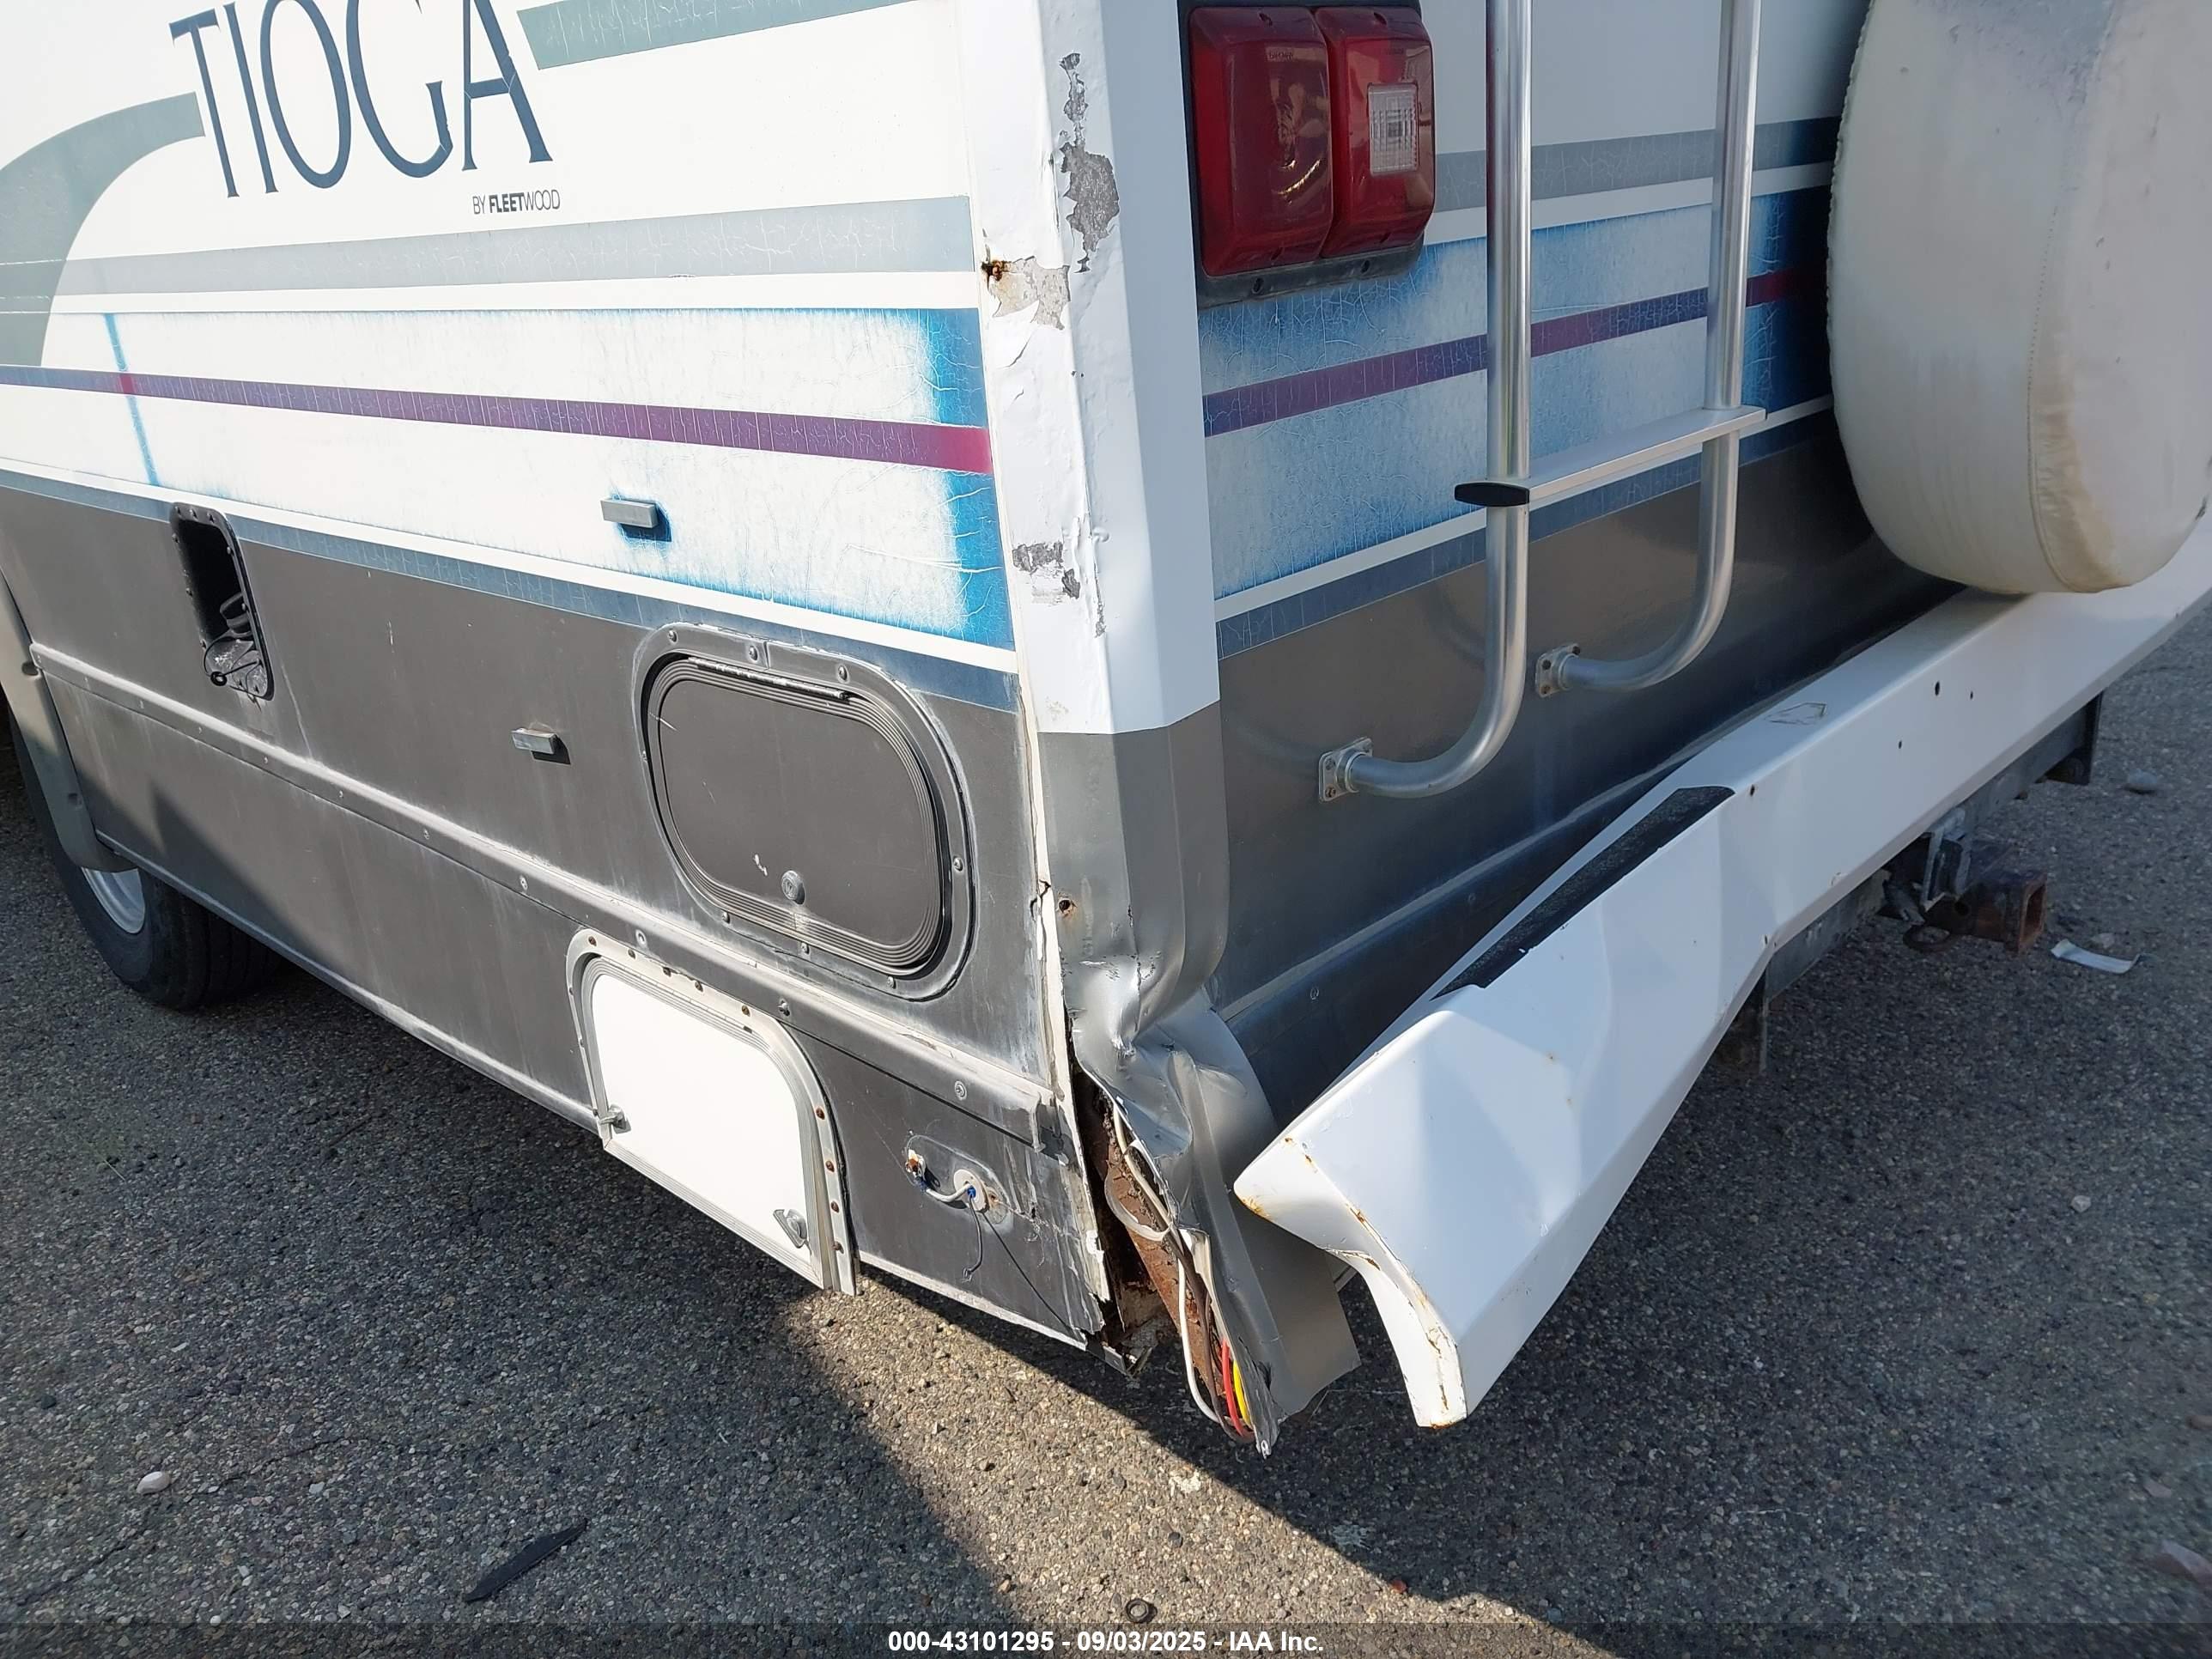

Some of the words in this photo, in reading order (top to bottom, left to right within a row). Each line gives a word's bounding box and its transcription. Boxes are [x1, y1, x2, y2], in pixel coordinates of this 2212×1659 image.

[168, 0, 553, 198] TIOGA
[472, 194, 487, 215] BY
[489, 189, 561, 213] FLEETWOOD
